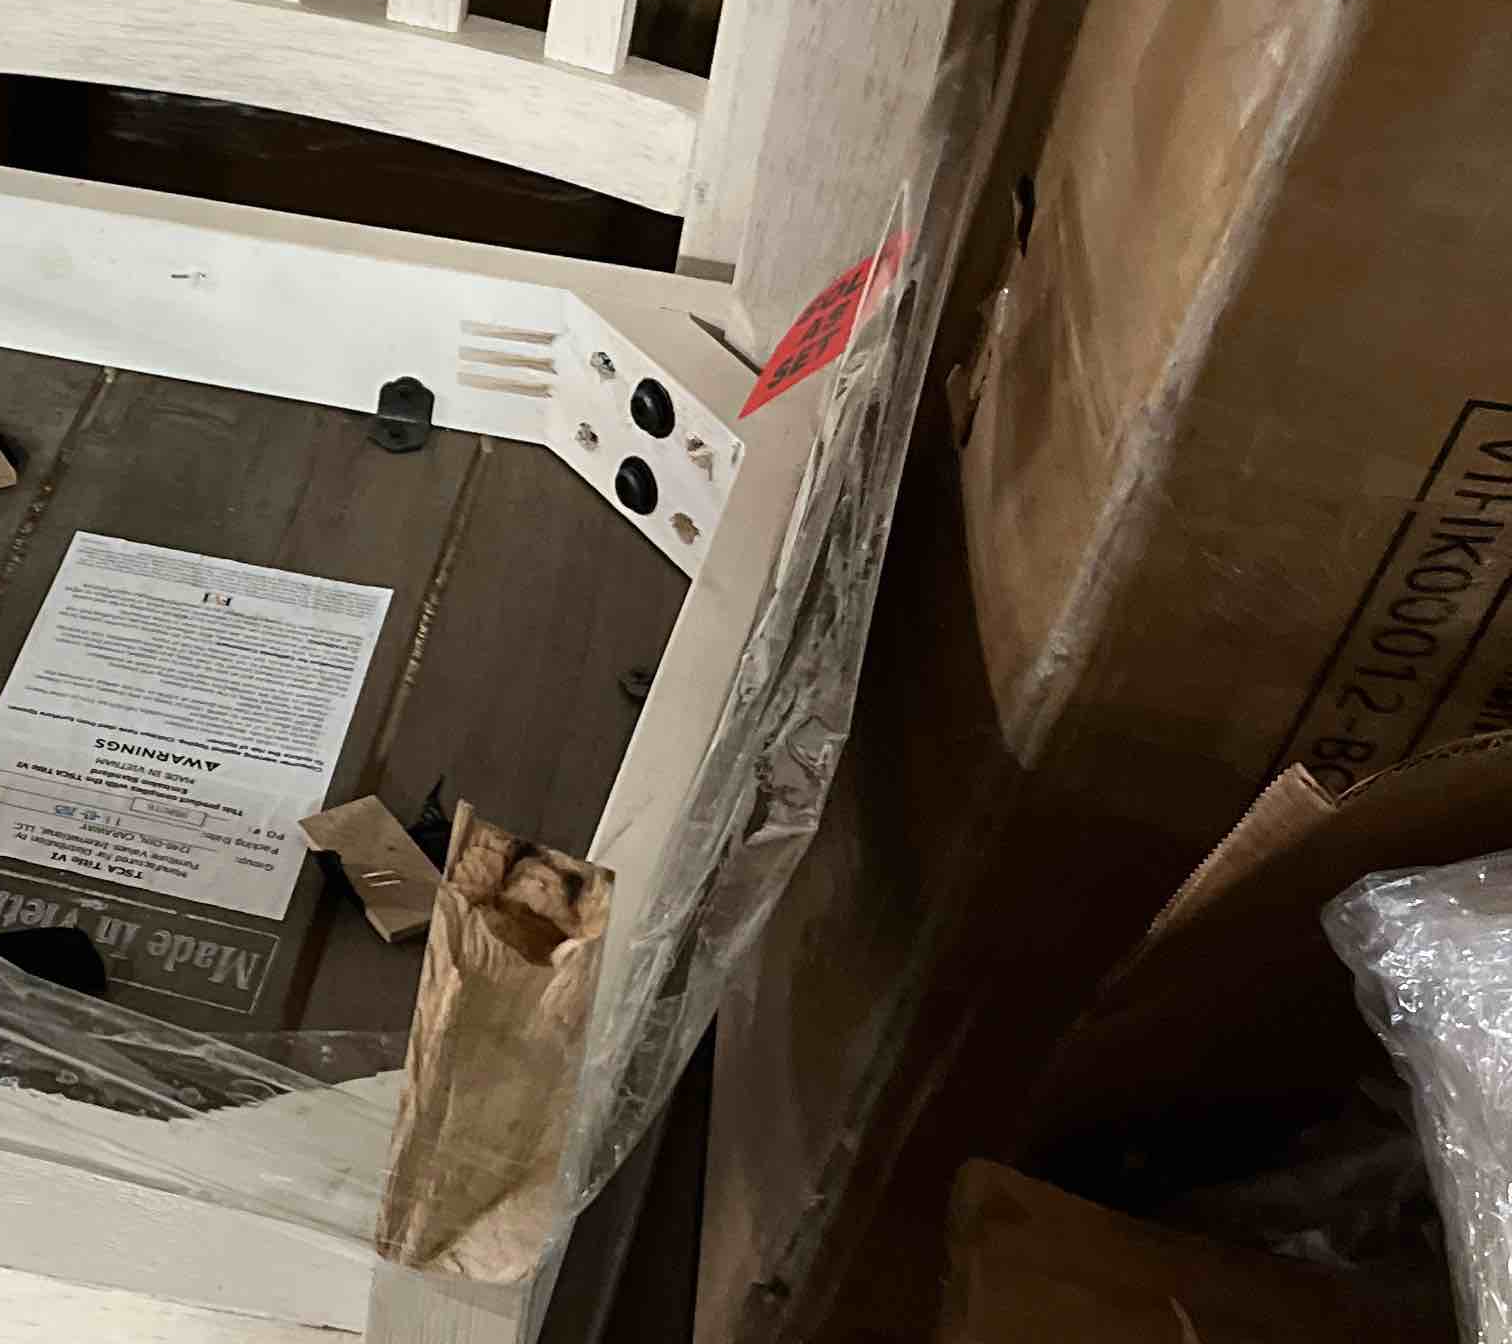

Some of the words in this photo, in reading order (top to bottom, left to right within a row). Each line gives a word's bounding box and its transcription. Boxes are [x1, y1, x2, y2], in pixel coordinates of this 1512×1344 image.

[92, 737, 204, 770] WARNINGS
[49, 851, 67, 862] VI
[69, 856, 102, 870] Title
[106, 864, 144, 879] TSCA
[147, 928, 261, 990] Made
